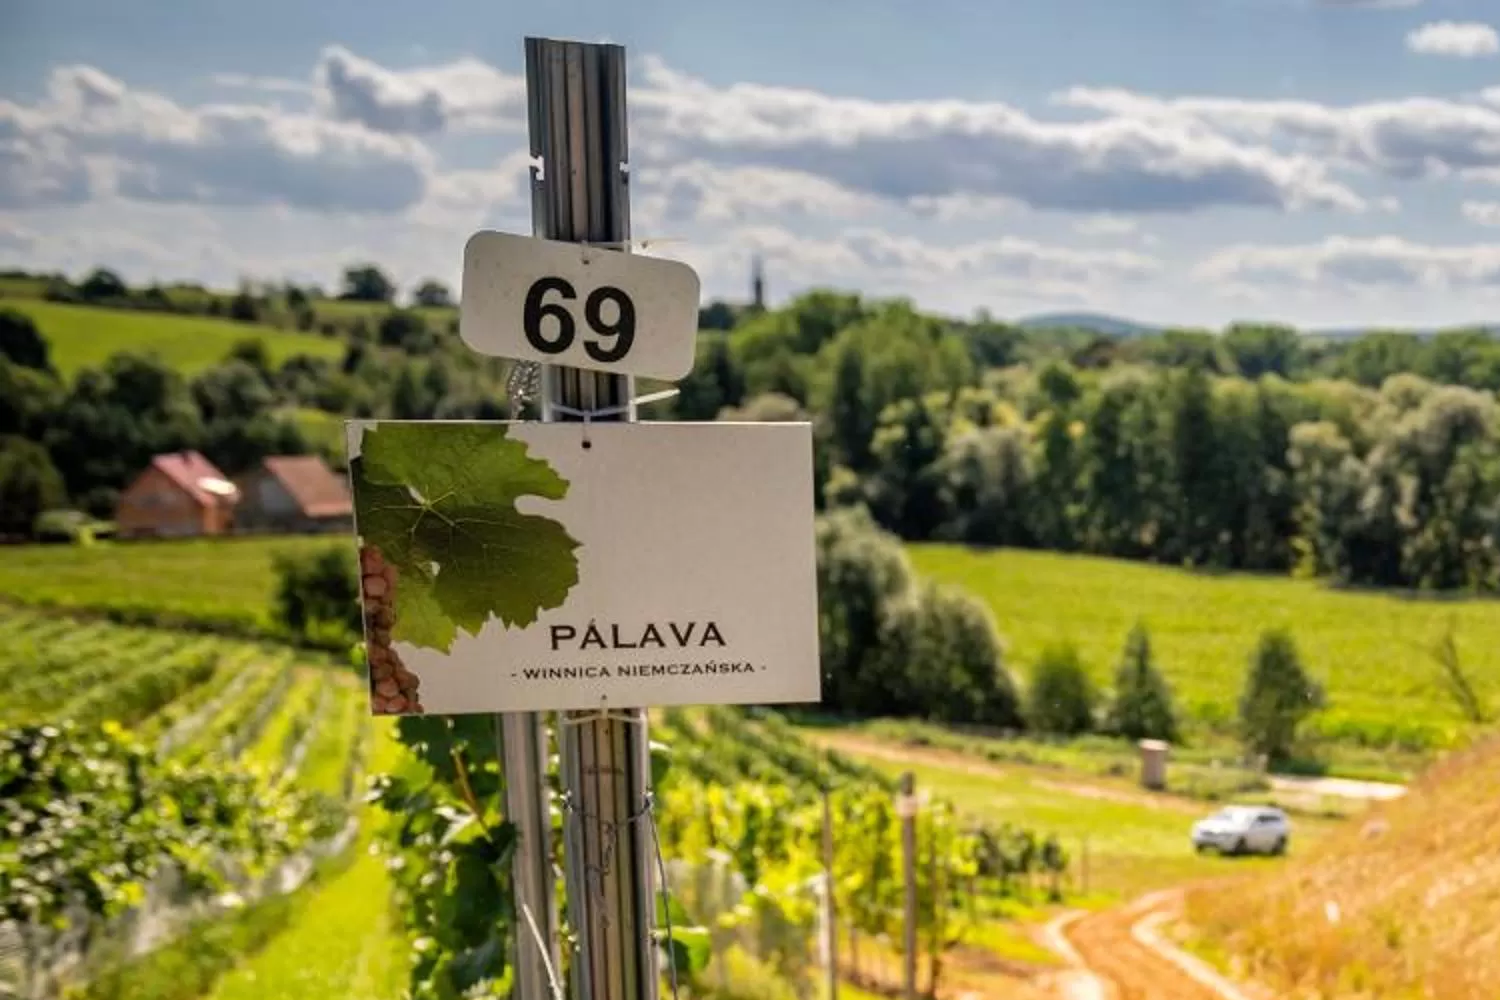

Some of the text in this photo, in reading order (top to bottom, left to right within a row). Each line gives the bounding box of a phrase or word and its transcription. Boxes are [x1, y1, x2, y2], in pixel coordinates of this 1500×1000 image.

[523, 275, 637, 363] 69
[549, 618, 727, 651] PÁLAVA
[522, 660, 755, 680] WINNICA NIEMCZAŃSKA
